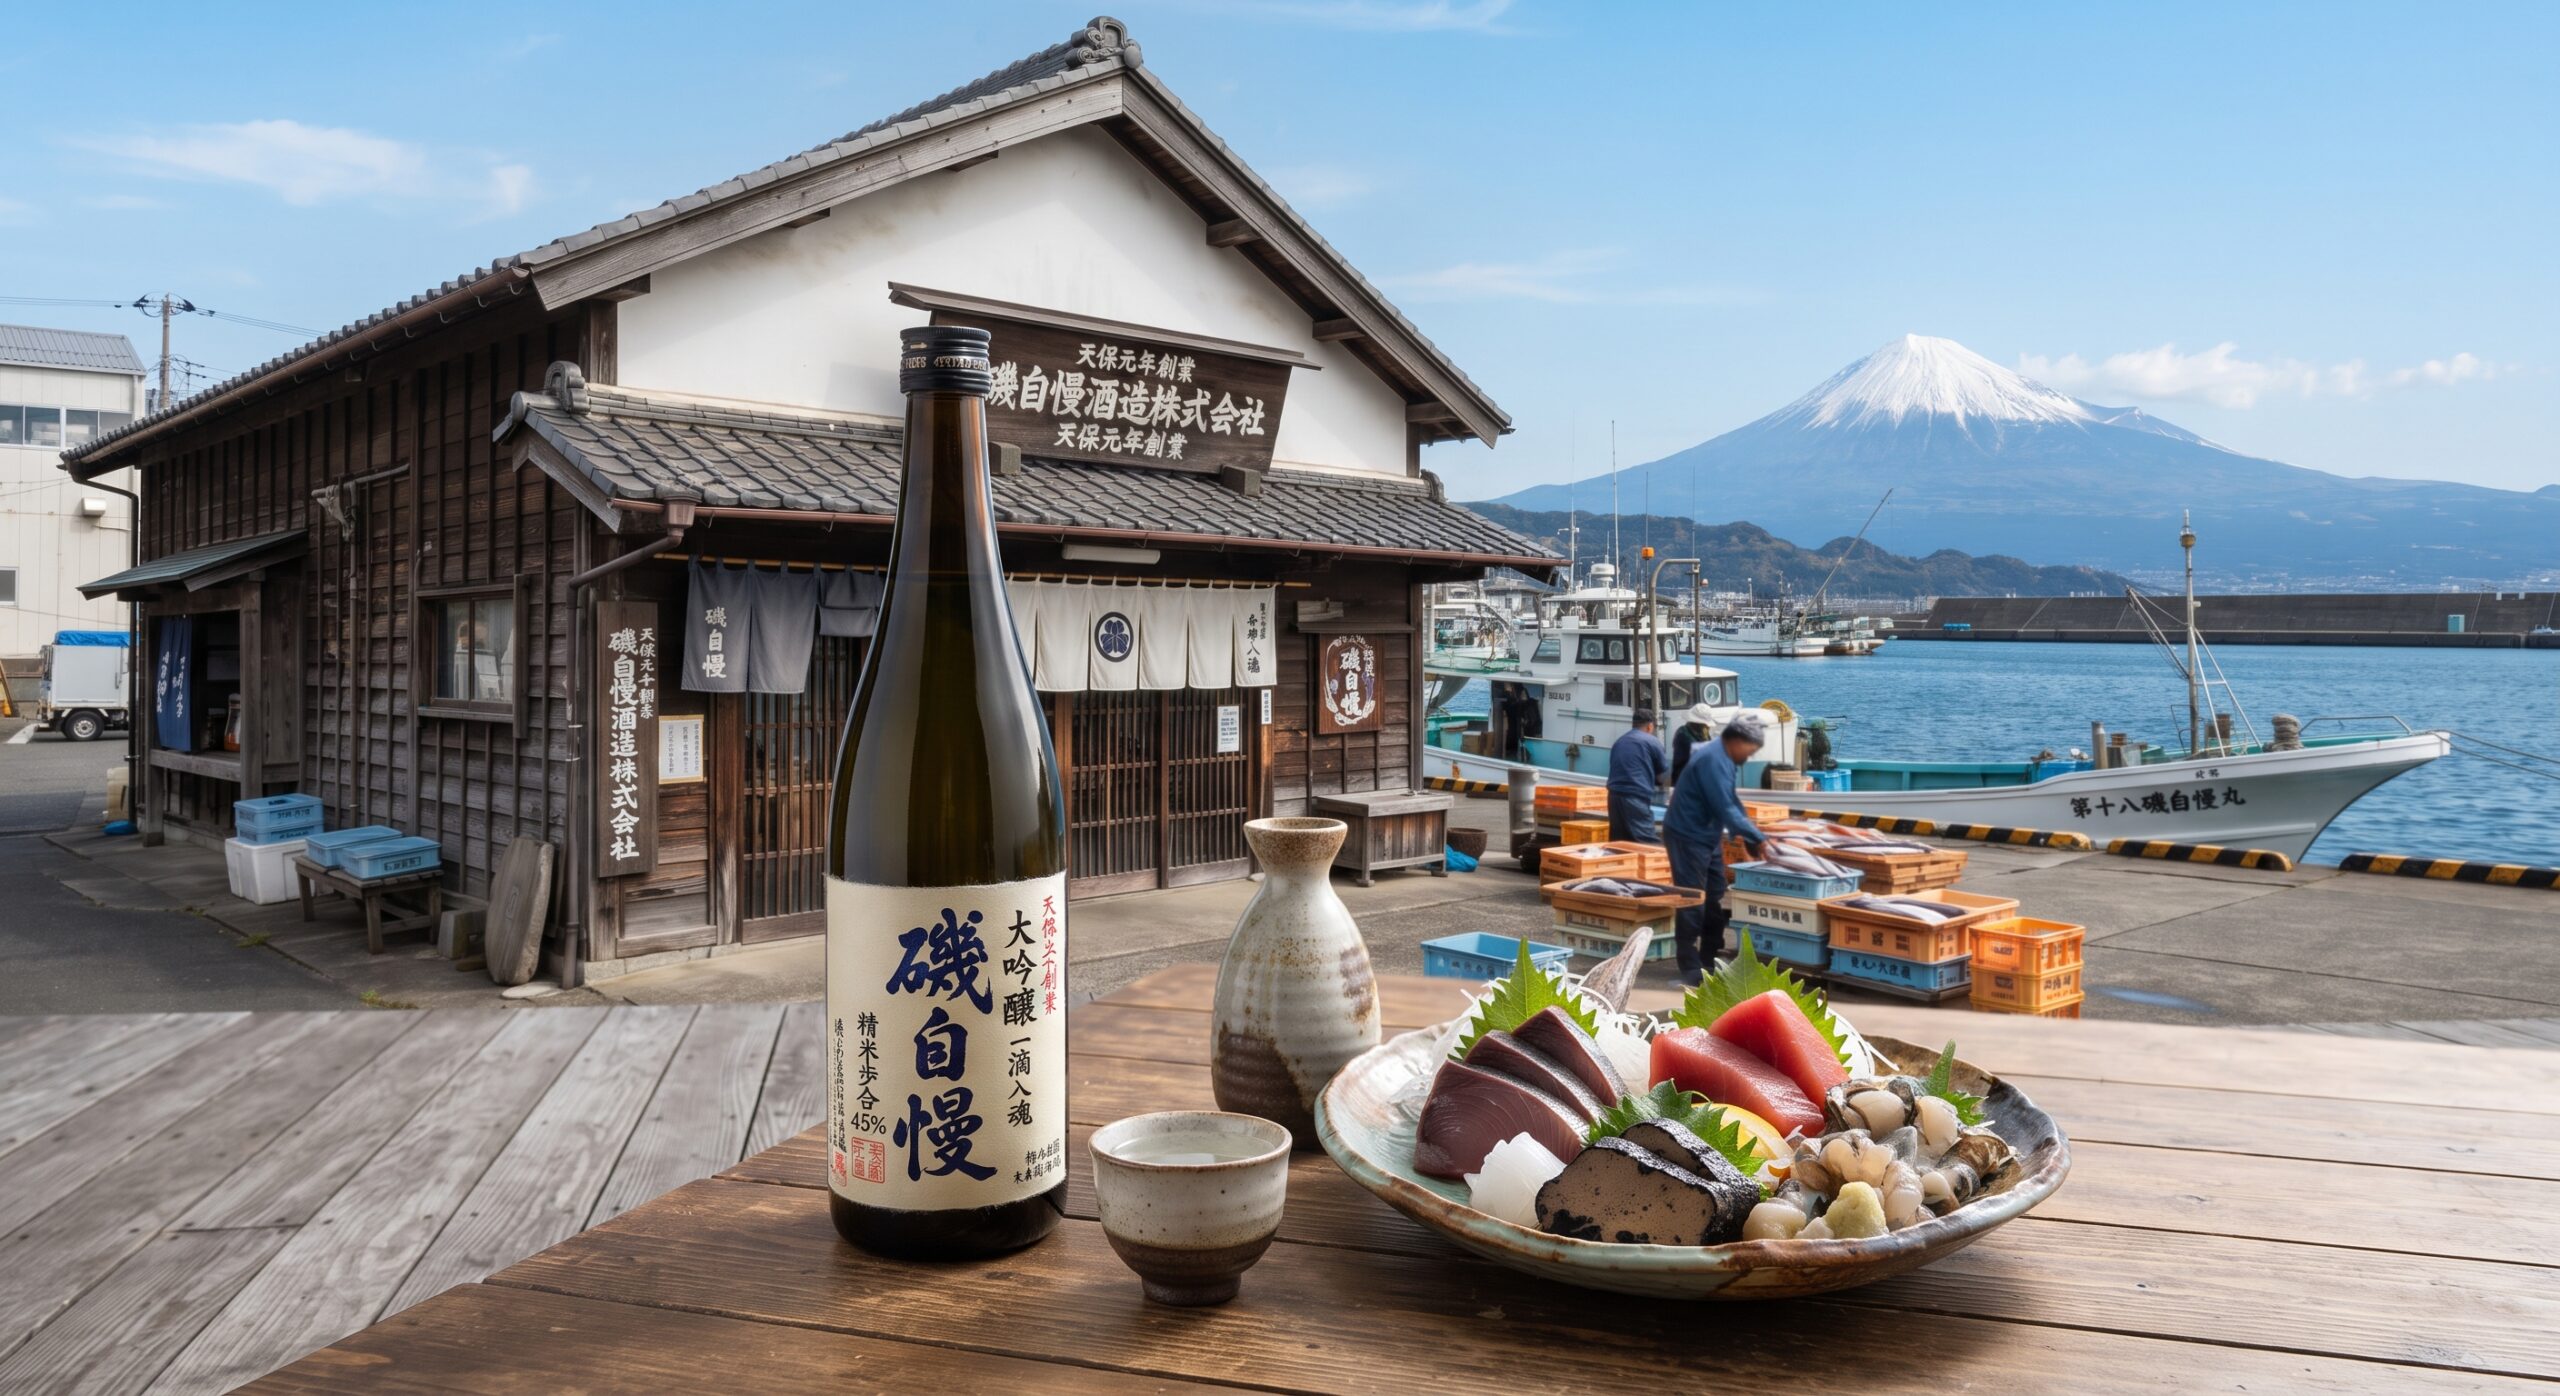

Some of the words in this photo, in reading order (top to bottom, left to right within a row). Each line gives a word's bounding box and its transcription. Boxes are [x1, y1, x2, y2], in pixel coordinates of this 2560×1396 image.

[1076, 343, 1196, 383] 天保元年創業
[985, 361, 1265, 436] 磯自慢酒造株式会社
[1053, 423, 1188, 460] 天保元年創業
[702, 606, 727, 678] 磯自慢
[608, 627, 639, 861] 磯自慢酒造株式会社
[2070, 786, 2246, 819] 第十八磯自慢丸
[886, 908, 998, 1181] 磯自慢
[850, 1112, 887, 1135] 45%
